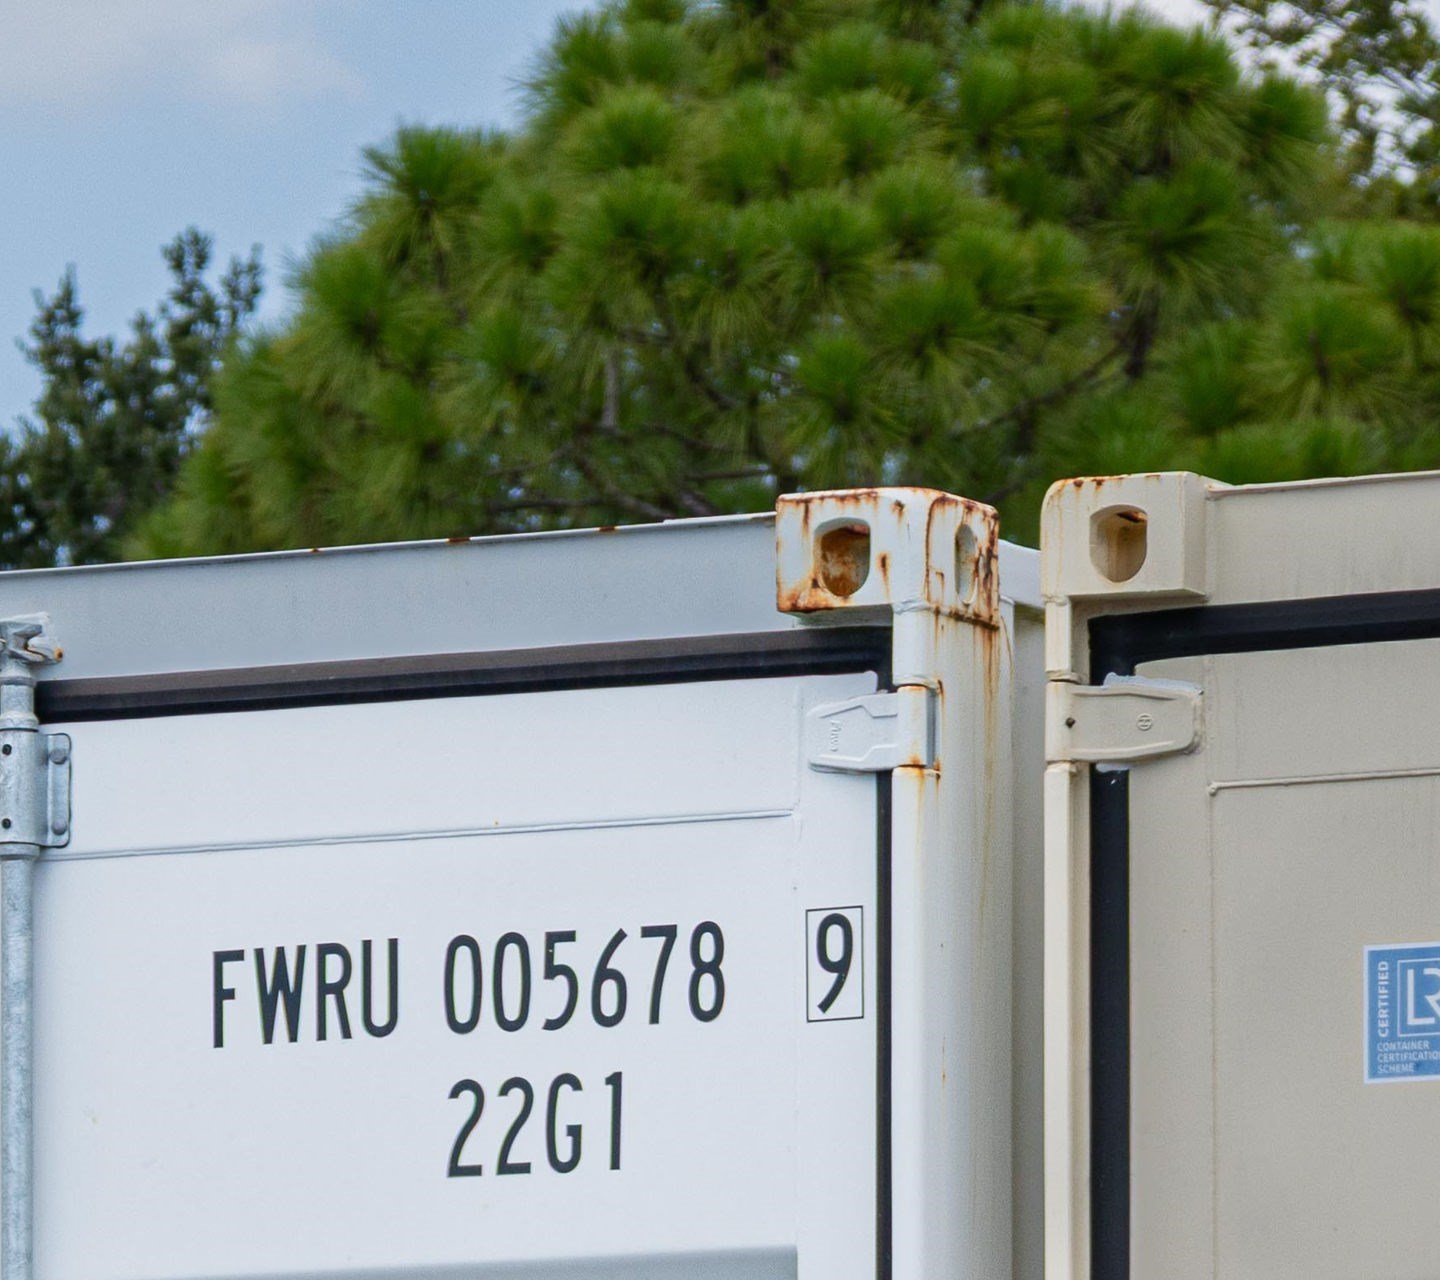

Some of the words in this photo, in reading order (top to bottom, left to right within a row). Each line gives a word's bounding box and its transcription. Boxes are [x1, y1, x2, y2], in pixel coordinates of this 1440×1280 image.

[213, 937, 400, 1048] FWRU
[443, 920, 726, 1035] 005678
[816, 913, 854, 1014] 9
[1377, 961, 1389, 1037] CERTIFIED
[1377, 1040, 1430, 1052] CONTAINER
[1377, 1062, 1415, 1074] SCHEME
[447, 1071, 624, 1178] 22G1
